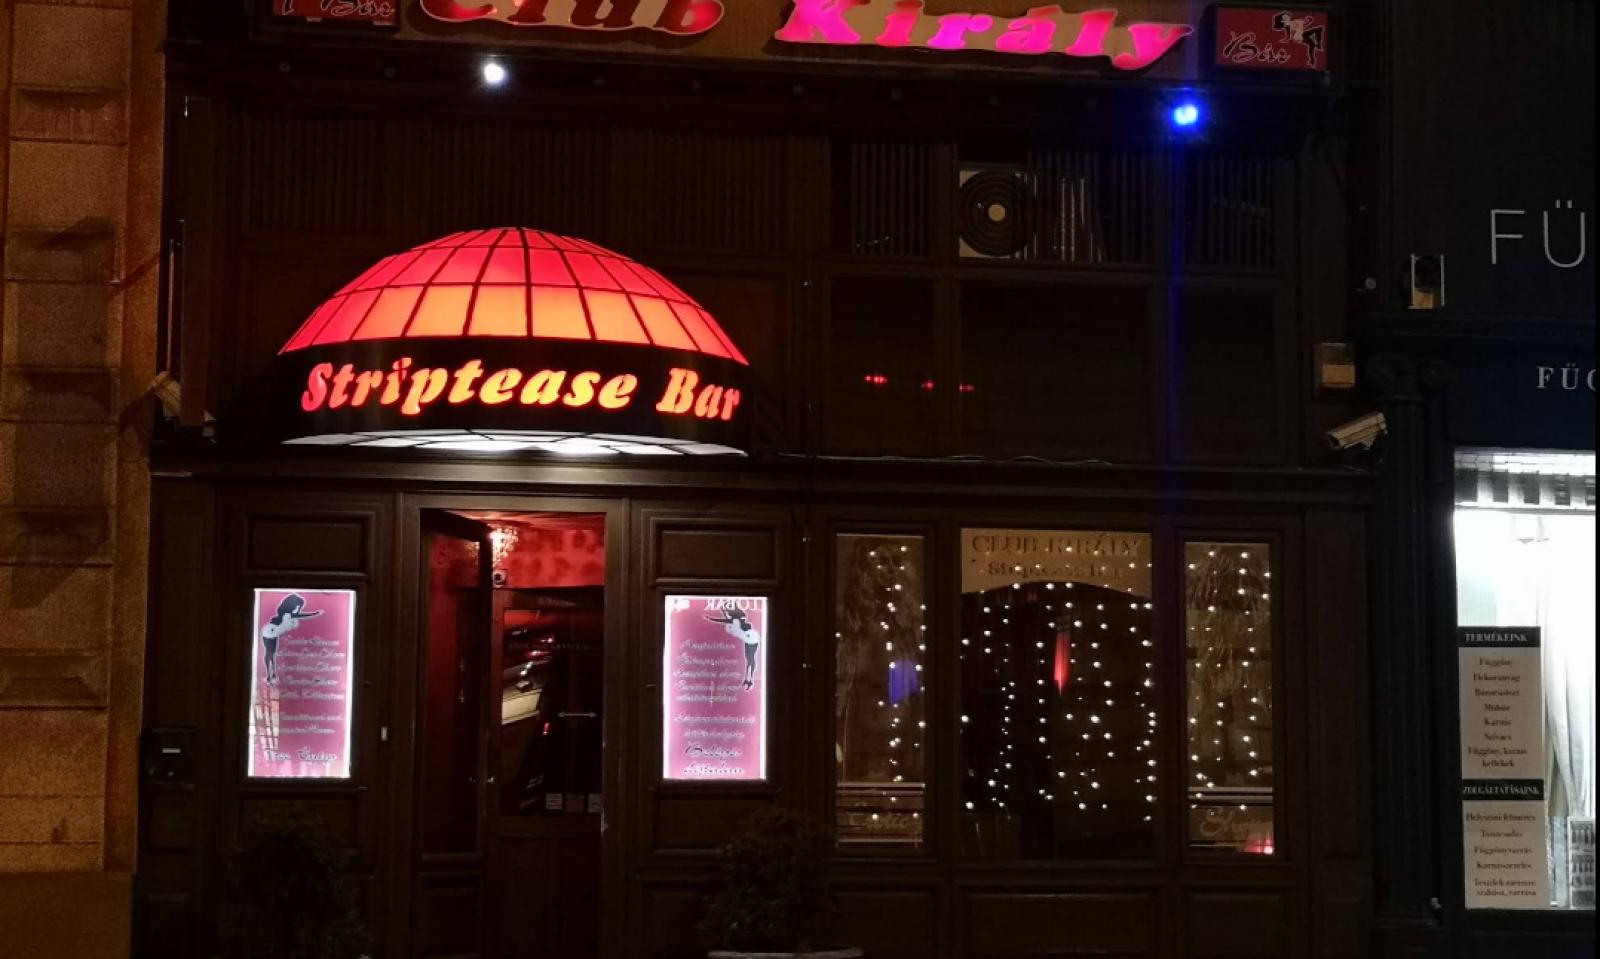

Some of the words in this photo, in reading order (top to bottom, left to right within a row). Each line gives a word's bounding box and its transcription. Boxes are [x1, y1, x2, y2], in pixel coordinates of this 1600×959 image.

[774, 0, 1194, 70] Király
[1490, 199, 1587, 268] FÜ
[301, 357, 639, 416] Striptease
[655, 366, 741, 421] Bar
[1464, 632, 1528, 642] TERMÉKEINK
